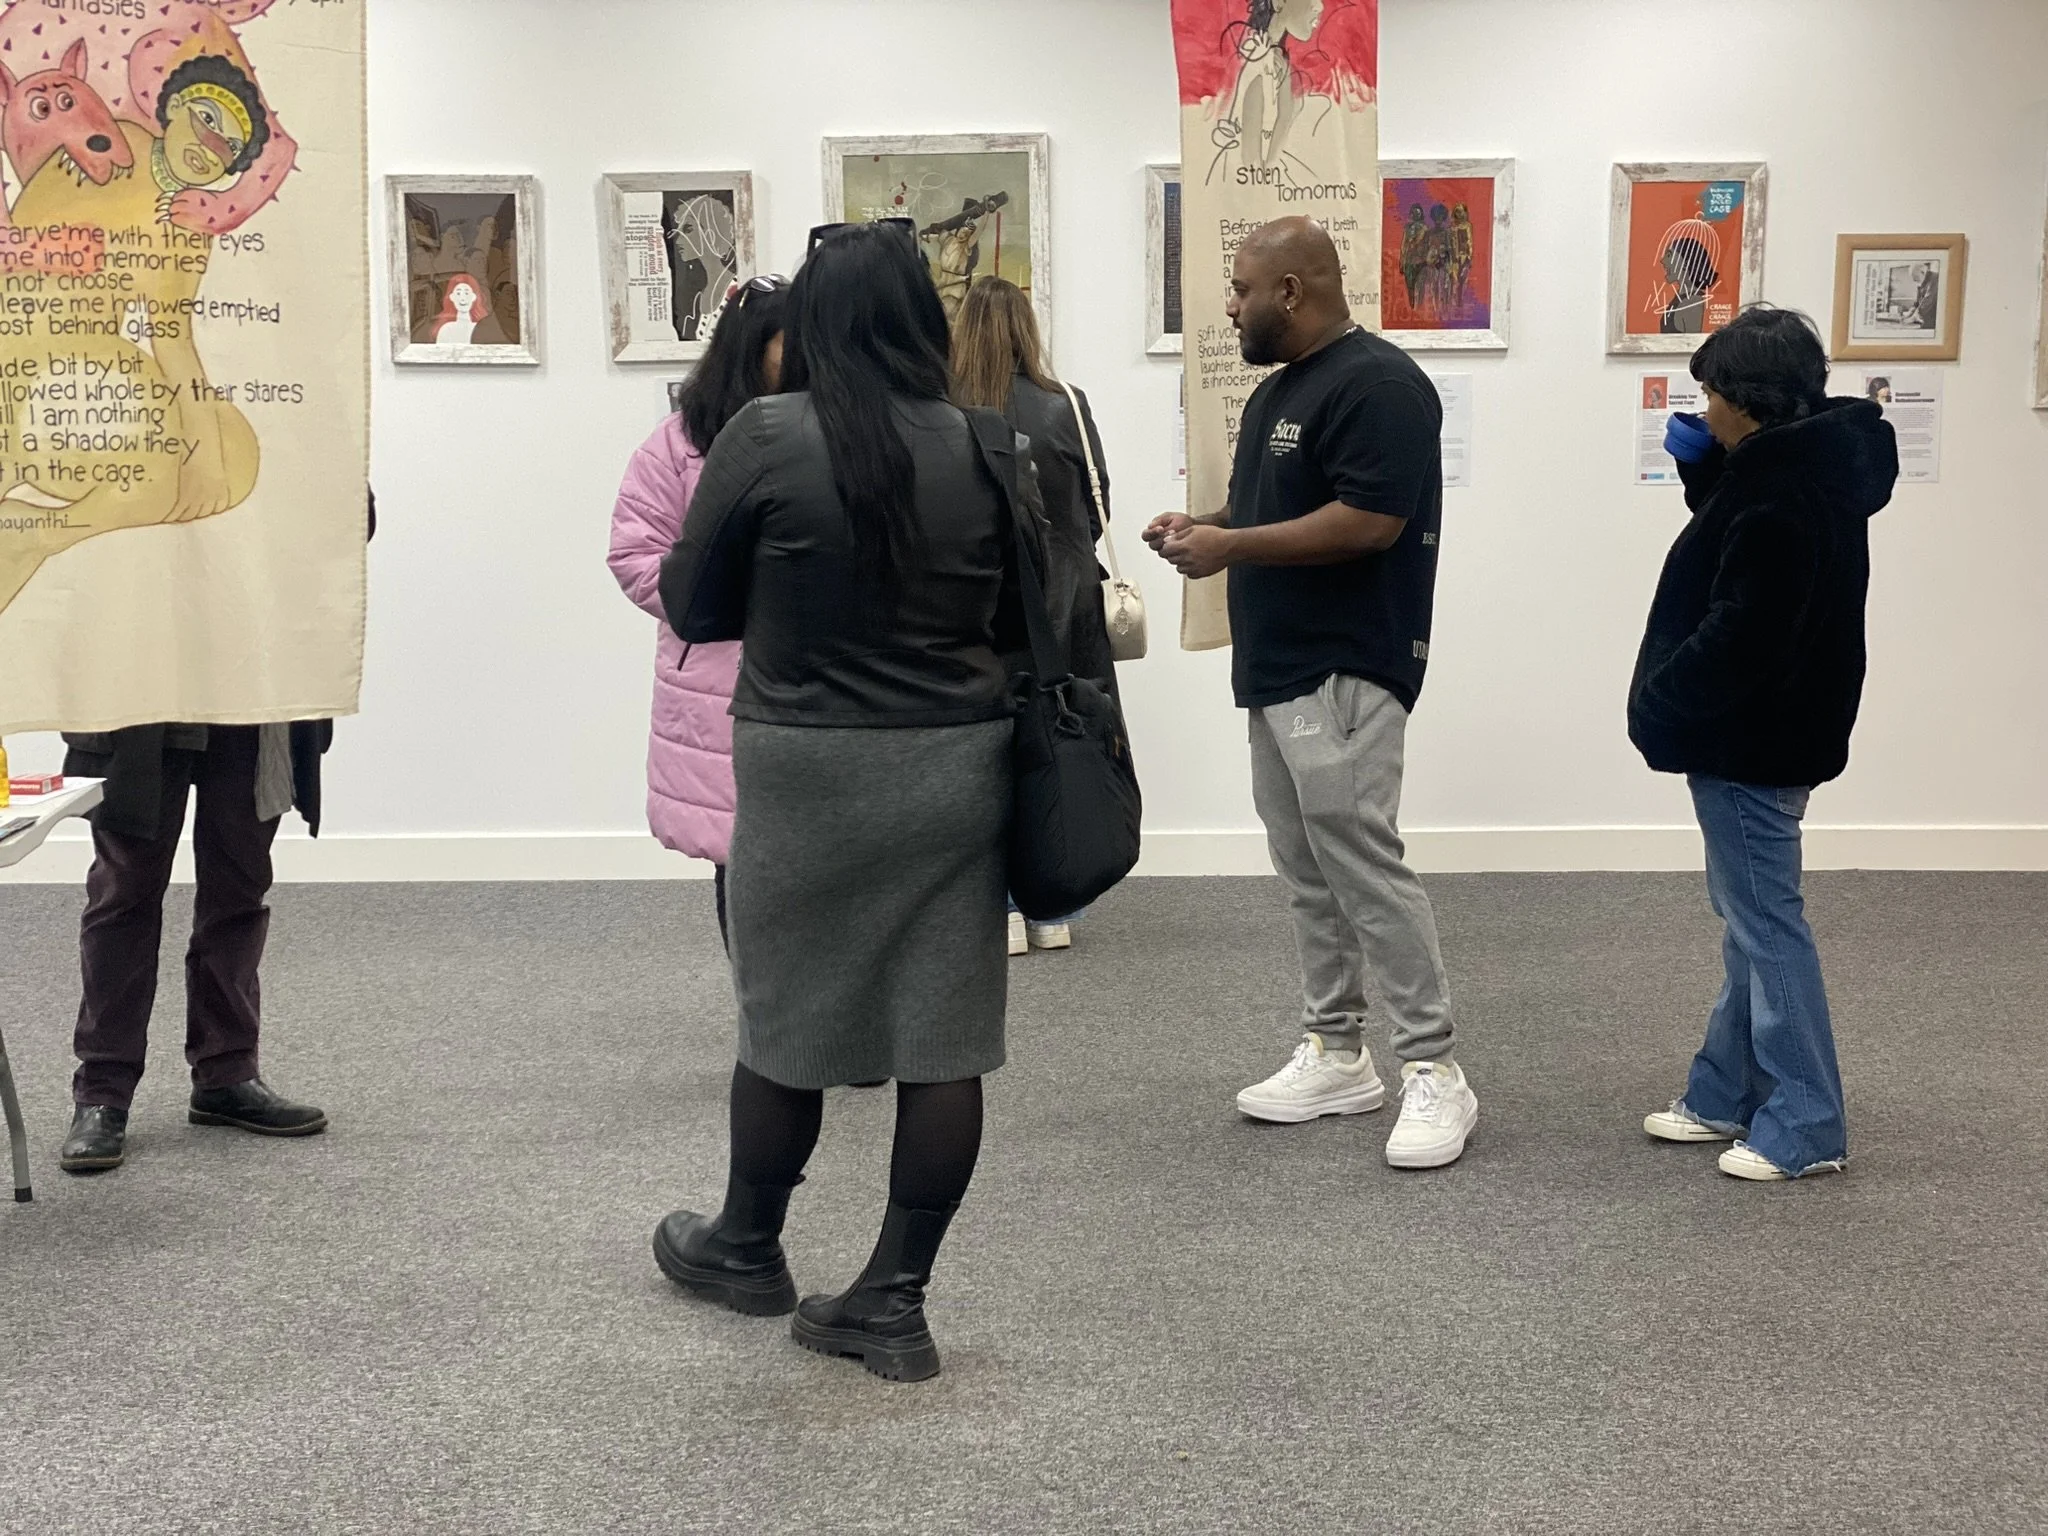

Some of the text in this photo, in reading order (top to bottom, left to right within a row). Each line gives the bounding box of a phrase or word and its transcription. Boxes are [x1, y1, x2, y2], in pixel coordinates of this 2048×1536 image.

[68, 226, 104, 243] me
[109, 225, 153, 248] with
[161, 223, 214, 249] their
[219, 233, 264, 256] eyes
[44, 243, 84, 267] into
[94, 251, 208, 274] memories
[6, 269, 134, 292] not choose
[0, 292, 63, 314] leave
[70, 297, 104, 313] me
[209, 298, 280, 327] emptied
[49, 314, 119, 336] behind
[127, 315, 180, 343] glass
[48, 352, 77, 376] bit
[84, 352, 113, 380] by
[117, 350, 144, 374] bit
[85, 376, 145, 401] whole
[151, 378, 181, 406] by
[191, 378, 237, 402] their
[30, 404, 35, 425] I
[43, 407, 79, 426] am
[86, 401, 165, 435] nothing
[22, 433, 38, 452] a
[50, 428, 139, 452] shadow
[144, 430, 200, 466] they
[14, 462, 39, 481] in
[48, 459, 86, 482] the
[92, 463, 152, 492] cage.
